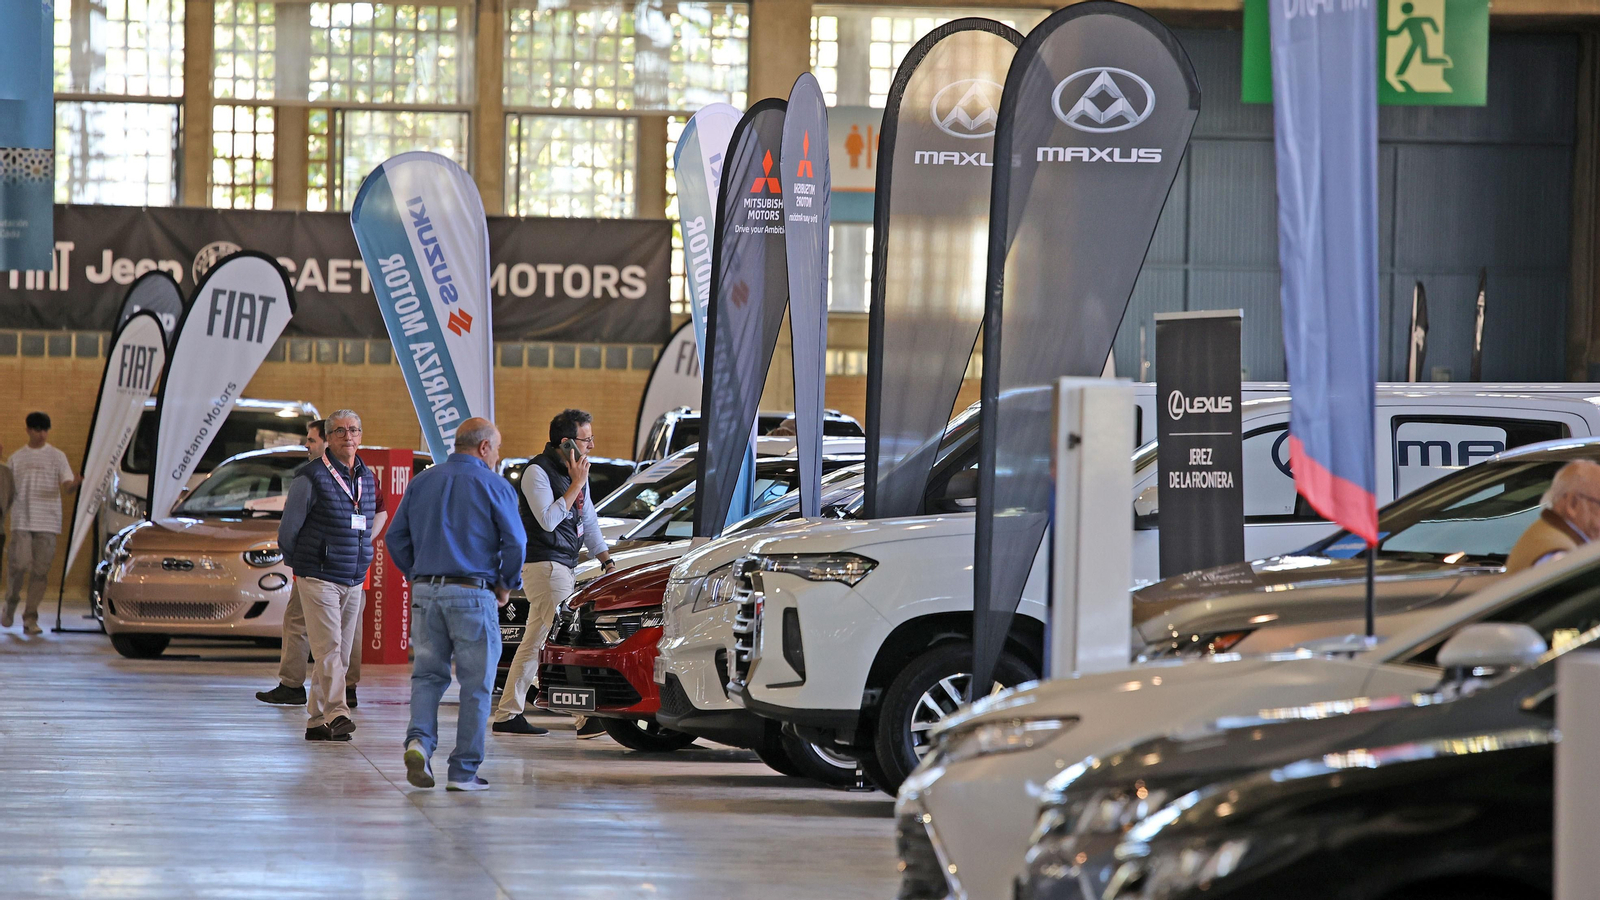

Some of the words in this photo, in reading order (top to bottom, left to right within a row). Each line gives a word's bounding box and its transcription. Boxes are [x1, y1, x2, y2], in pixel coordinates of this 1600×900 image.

[914, 150, 994, 166] MAXU
[1036, 146, 1163, 163] MAXUS
[743, 198, 783, 209] MITSUBISH
[747, 210, 780, 221] MOTORS
[734, 224, 750, 233] Drive
[750, 226, 764, 235] your
[764, 225, 785, 234] Ambiti
[206, 288, 277, 344] FIAT
[118, 344, 157, 390] FIAT
[1185, 396, 1233, 413] LEXUS
[171, 428, 209, 481] Caetano
[203, 381, 237, 427] Motors
[1189, 448, 1213, 466] JEREZ
[87, 466, 113, 515] Caetano
[111, 426, 132, 467] Motors
[1169, 472, 1180, 488] DE
[1180, 472, 1192, 488] LA
[1192, 471, 1234, 488] FRONTERA
[391, 466, 411, 495] FIAT
[373, 539, 384, 588] Motors
[371, 590, 384, 650] Caetano
[400, 591, 409, 650] Caetano
[552, 692, 590, 706] COLT
